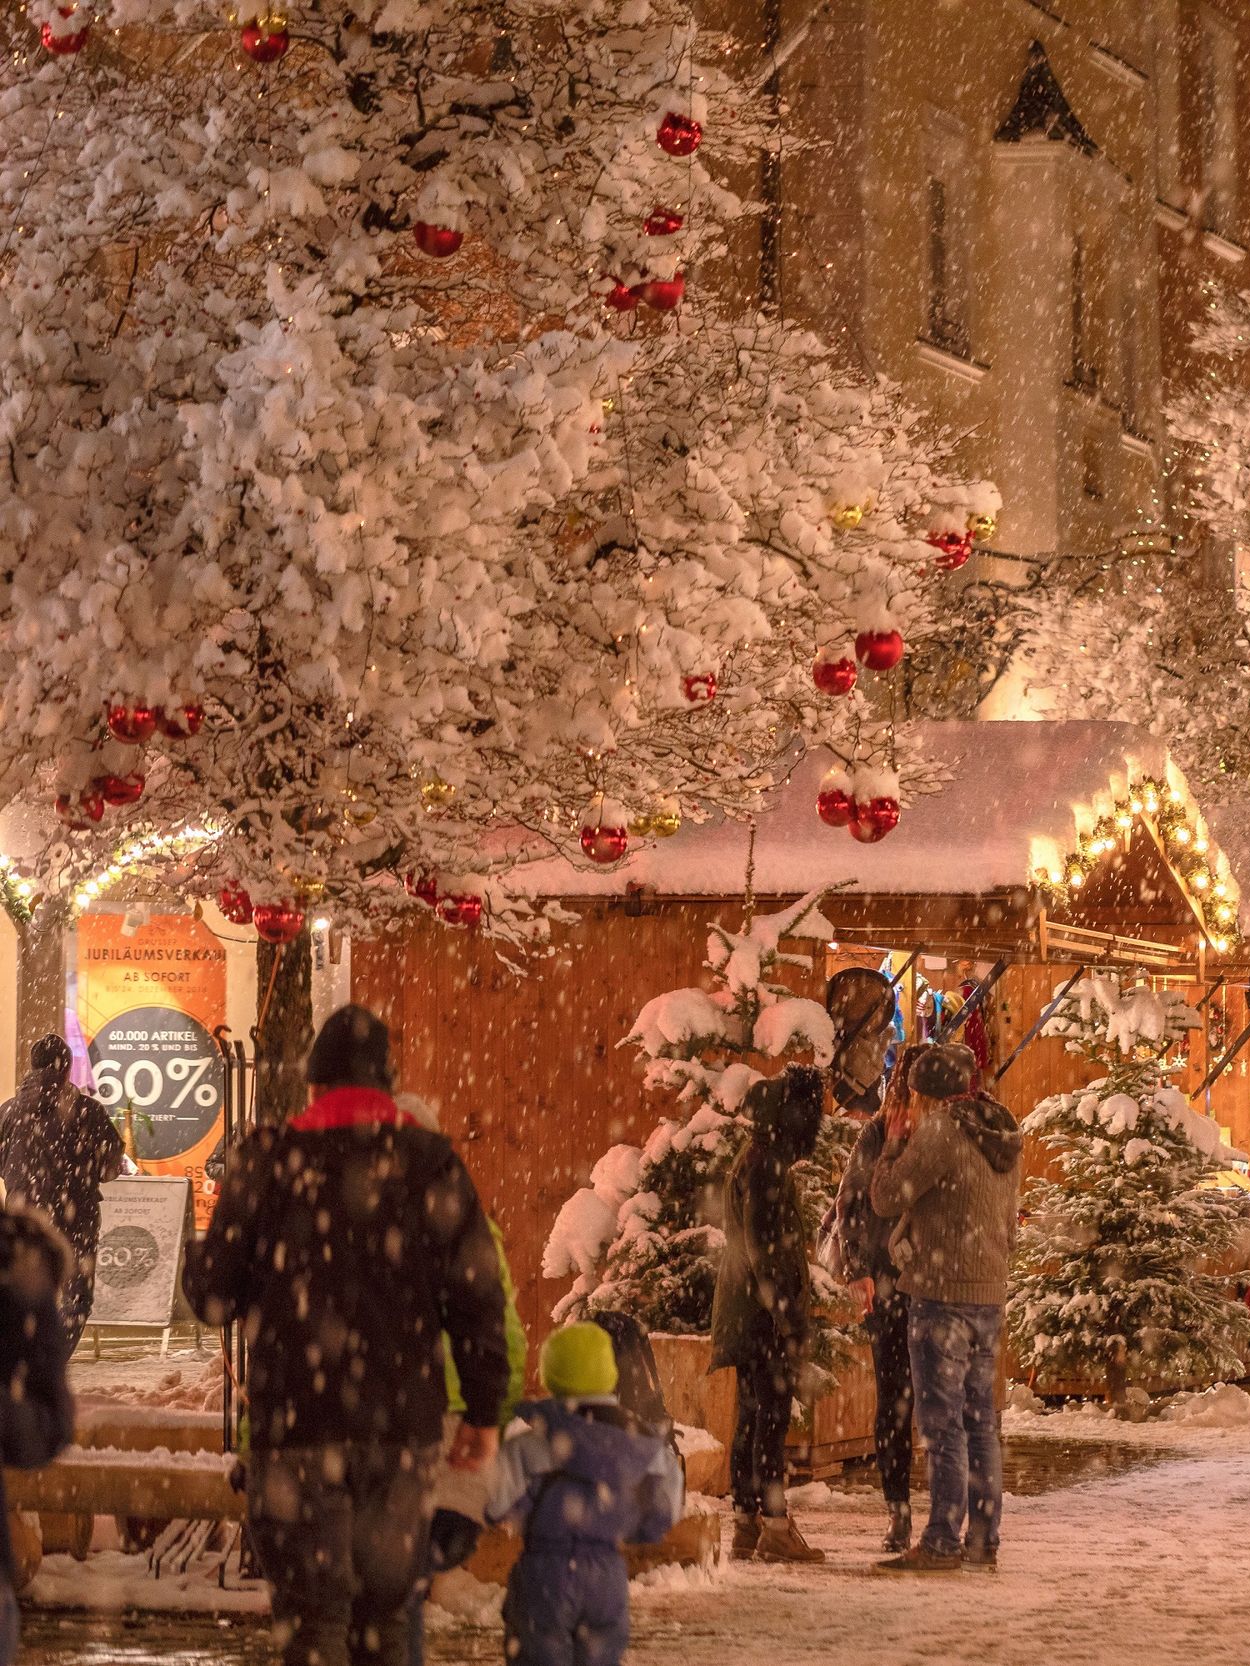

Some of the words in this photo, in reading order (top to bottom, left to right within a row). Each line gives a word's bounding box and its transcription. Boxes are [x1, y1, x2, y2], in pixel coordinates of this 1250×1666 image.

[124, 972, 139, 981] AB
[144, 972, 191, 982] SOFORT
[109, 1031, 149, 1041] 60.000
[151, 1031, 198, 1041] ARTIKEL
[92, 1057, 218, 1109] 60%
